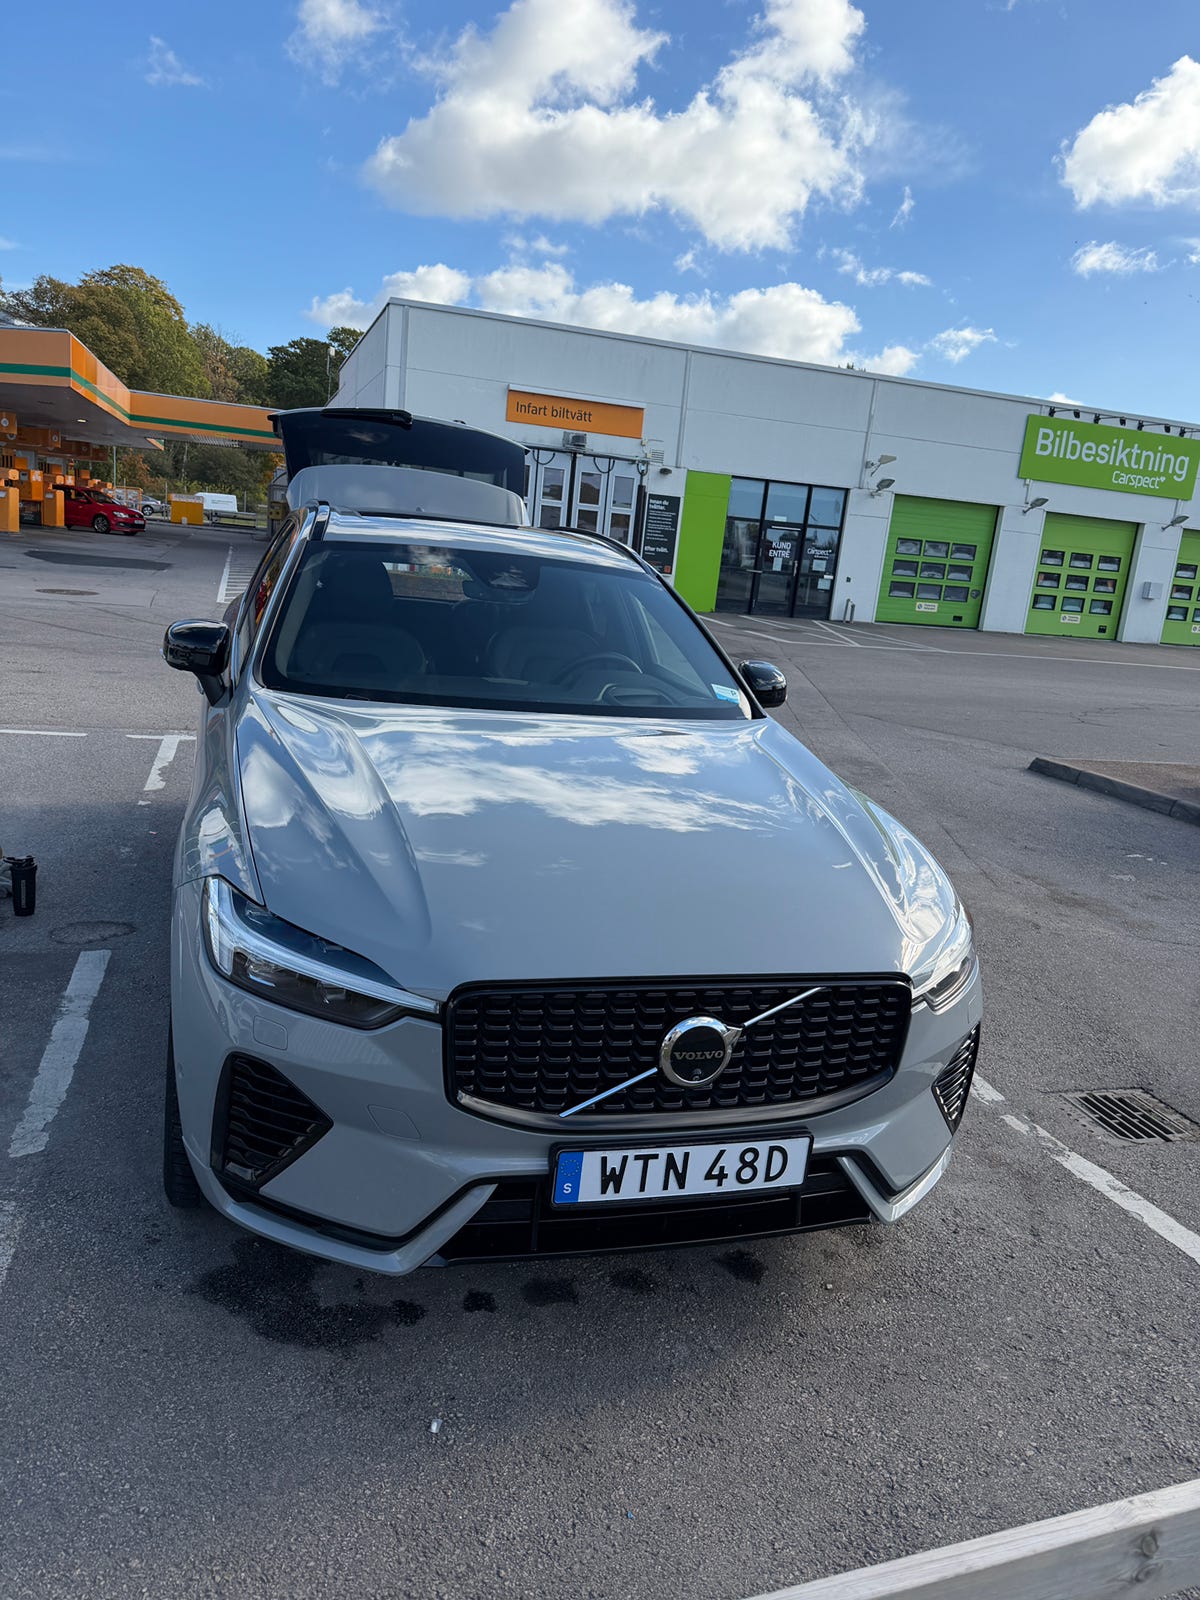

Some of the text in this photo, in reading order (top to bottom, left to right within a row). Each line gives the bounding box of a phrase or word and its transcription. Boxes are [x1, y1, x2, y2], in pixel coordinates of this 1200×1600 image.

[516, 401, 593, 423] Infart biltvätt
[1035, 427, 1189, 482] Bilbesiktning
[1112, 470, 1160, 489] Carspect
[772, 541, 791, 550] KUND
[673, 1049, 724, 1061] VOLVO
[600, 1145, 789, 1195] WTN 48D
[563, 1183, 573, 1194] S
